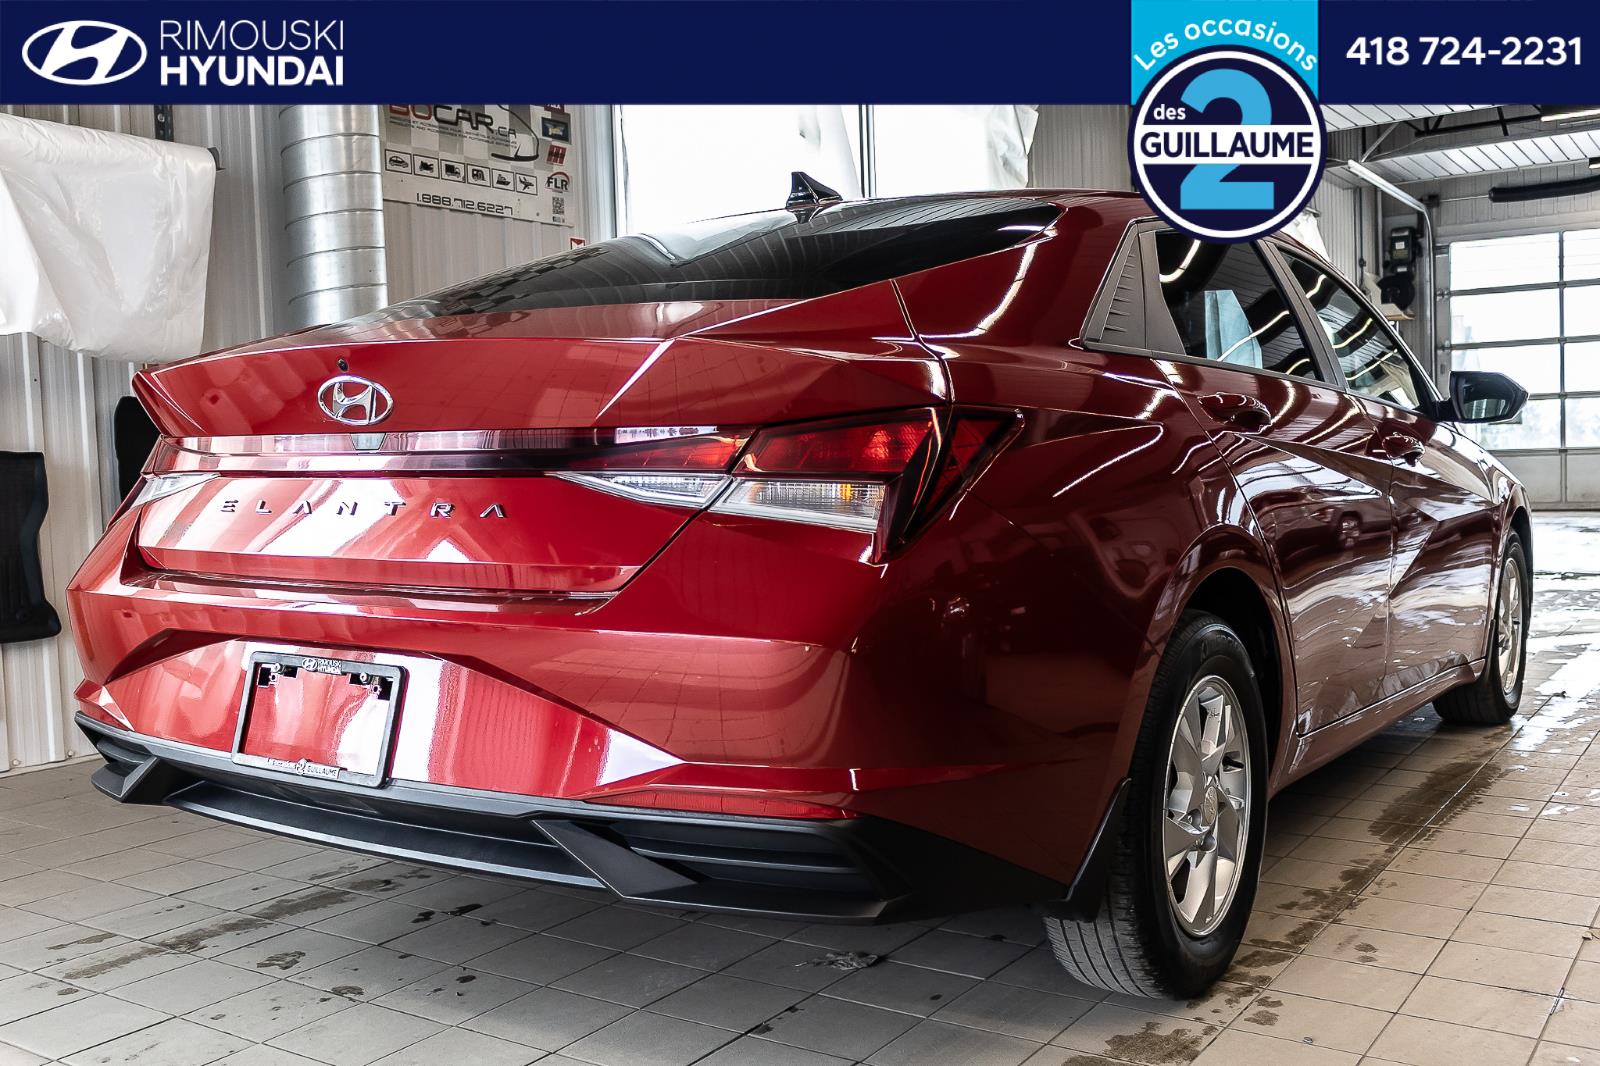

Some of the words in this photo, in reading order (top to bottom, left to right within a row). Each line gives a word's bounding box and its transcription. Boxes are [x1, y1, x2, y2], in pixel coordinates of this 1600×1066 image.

[546, 176, 569, 191] FLR
[416, 192, 513, 216] 1.888.712.6227
[220, 499, 506, 519] ELANTRA
